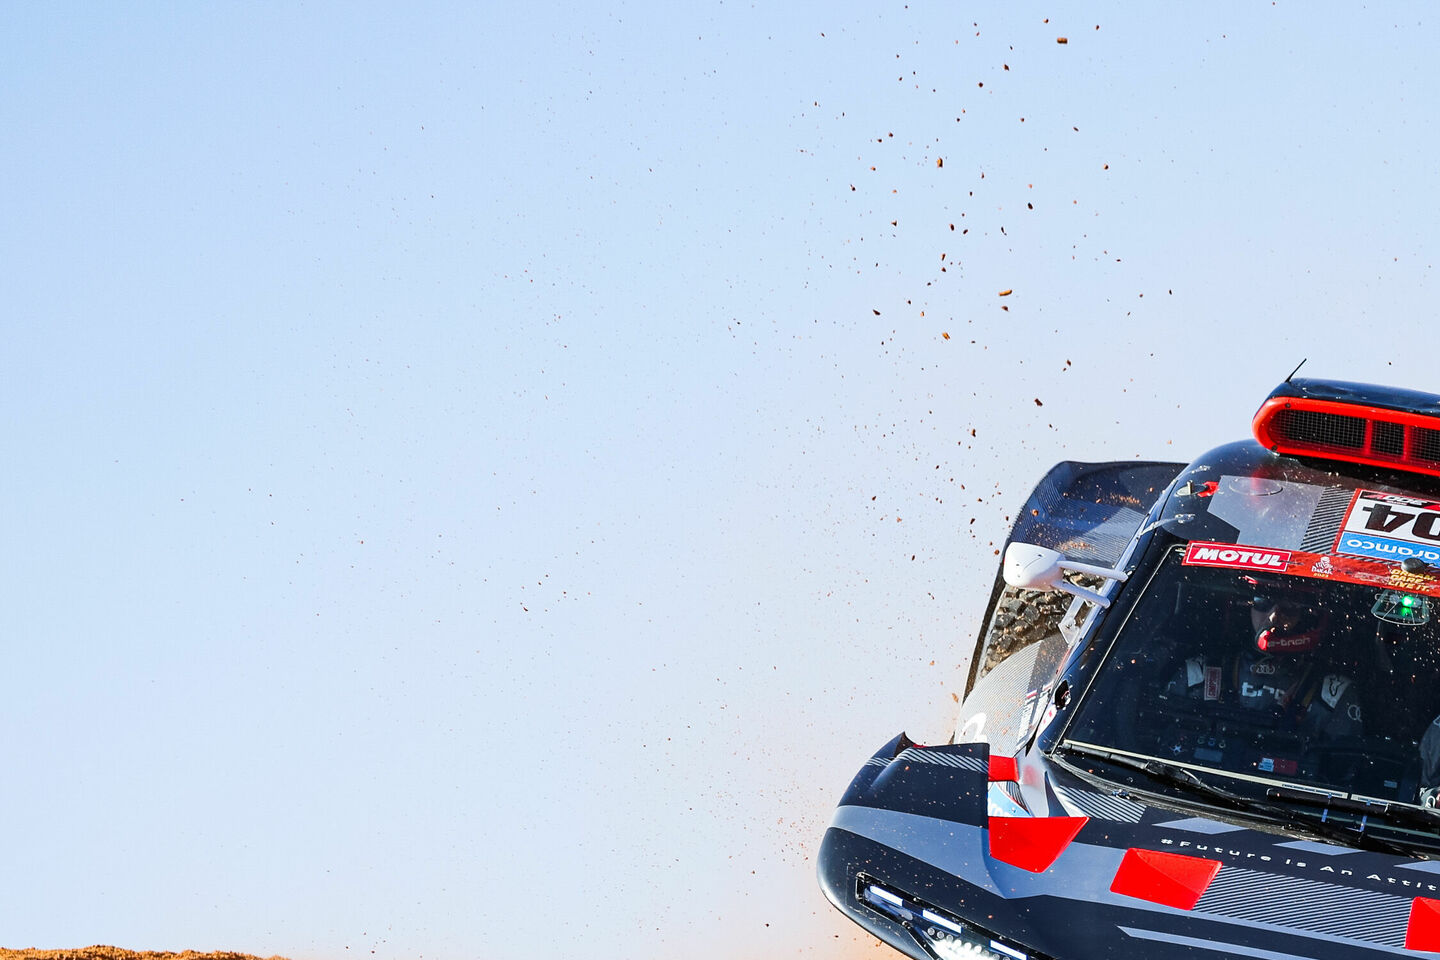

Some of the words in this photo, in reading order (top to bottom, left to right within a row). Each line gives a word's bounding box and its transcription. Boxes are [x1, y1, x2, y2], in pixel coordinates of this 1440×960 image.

[1193, 548, 1285, 566] MOTUL
[1346, 539, 1440, 560] aramco
[1388, 580, 1416, 590] LIVE
[1161, 837, 1272, 862] #Future
[1320, 865, 1353, 876] An
